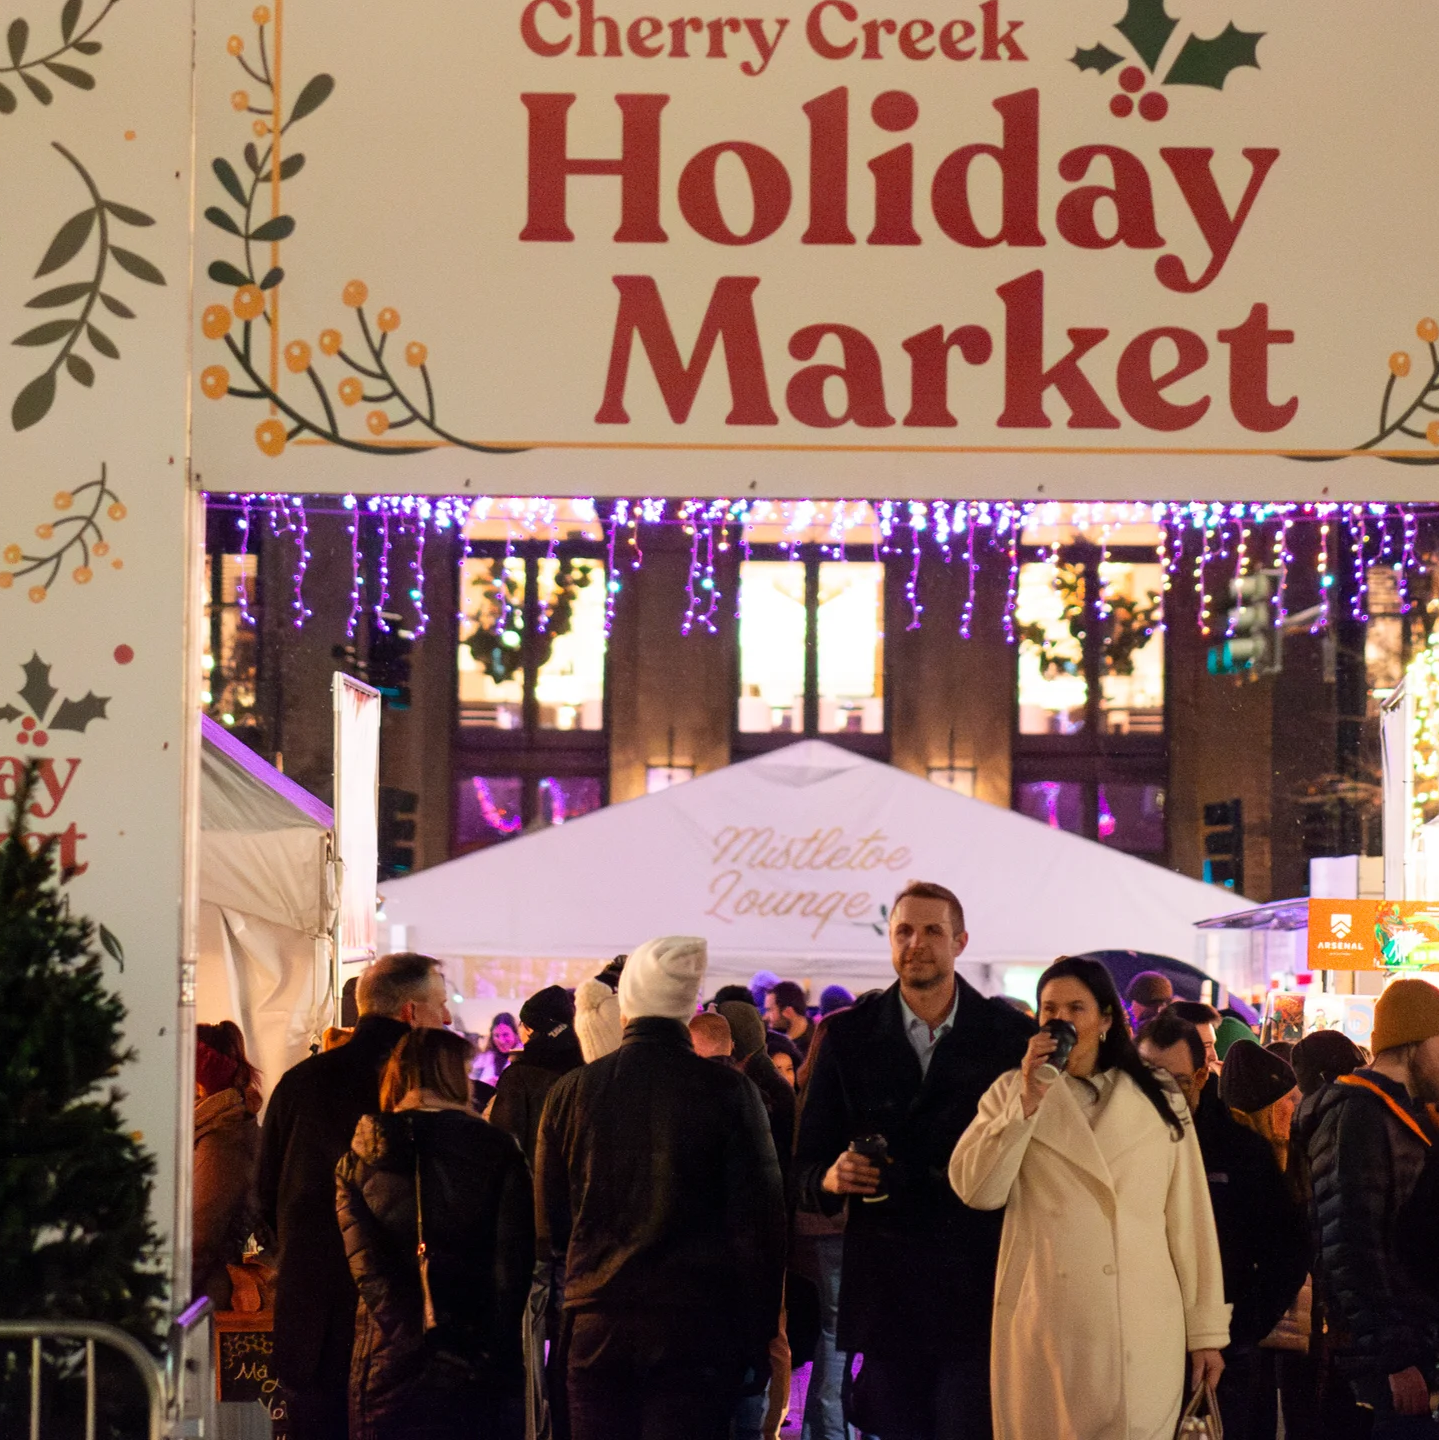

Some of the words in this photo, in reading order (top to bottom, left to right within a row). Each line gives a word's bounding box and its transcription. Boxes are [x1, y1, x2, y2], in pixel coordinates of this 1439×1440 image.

[518, 84, 1281, 294] Holiday
[594, 269, 1299, 433] Market
[712, 825, 912, 872] Mistletoe
[704, 869, 873, 941] Lounge
[1317, 941, 1364, 951] ARSENAL
